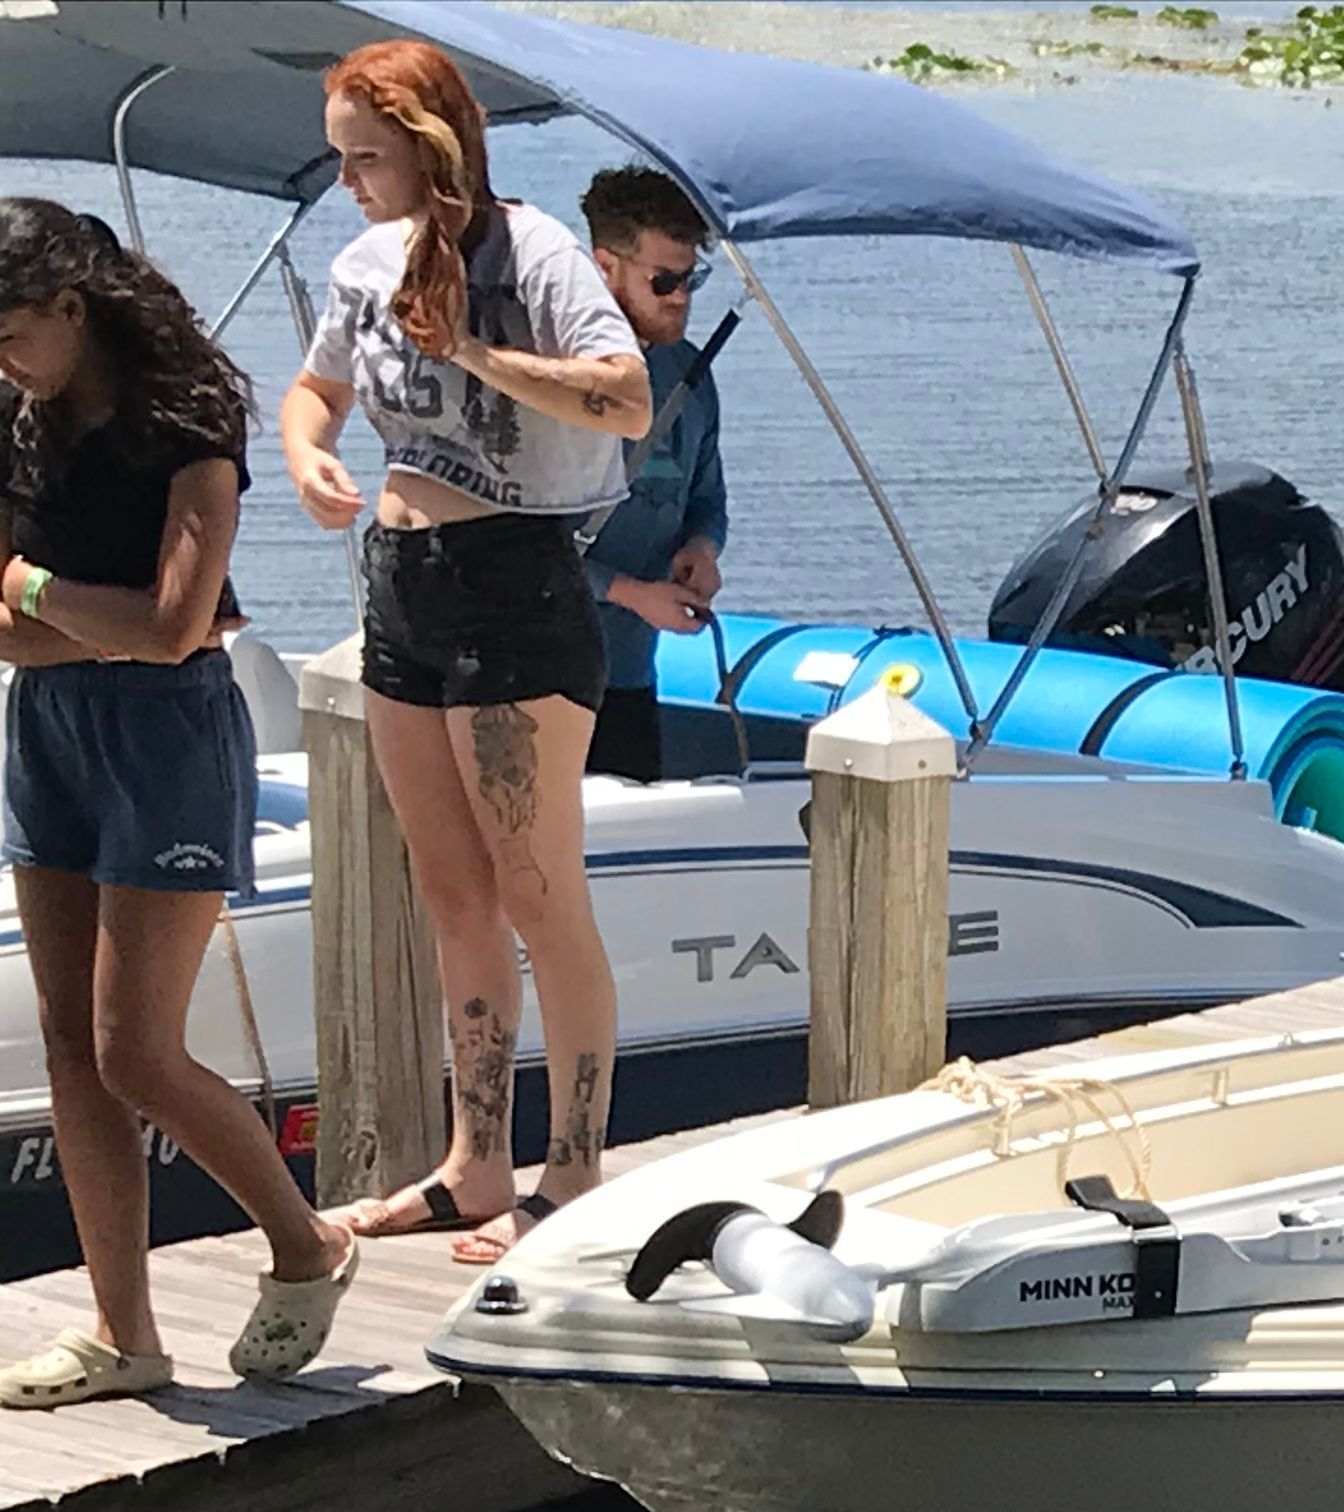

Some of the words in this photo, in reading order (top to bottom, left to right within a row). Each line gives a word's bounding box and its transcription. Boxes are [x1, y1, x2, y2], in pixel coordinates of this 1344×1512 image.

[1176, 542, 1309, 675] RCURY
[671, 909, 999, 983] TAE
[1019, 1275, 1093, 1302] MINN
[1100, 1272, 1136, 1297] KO
